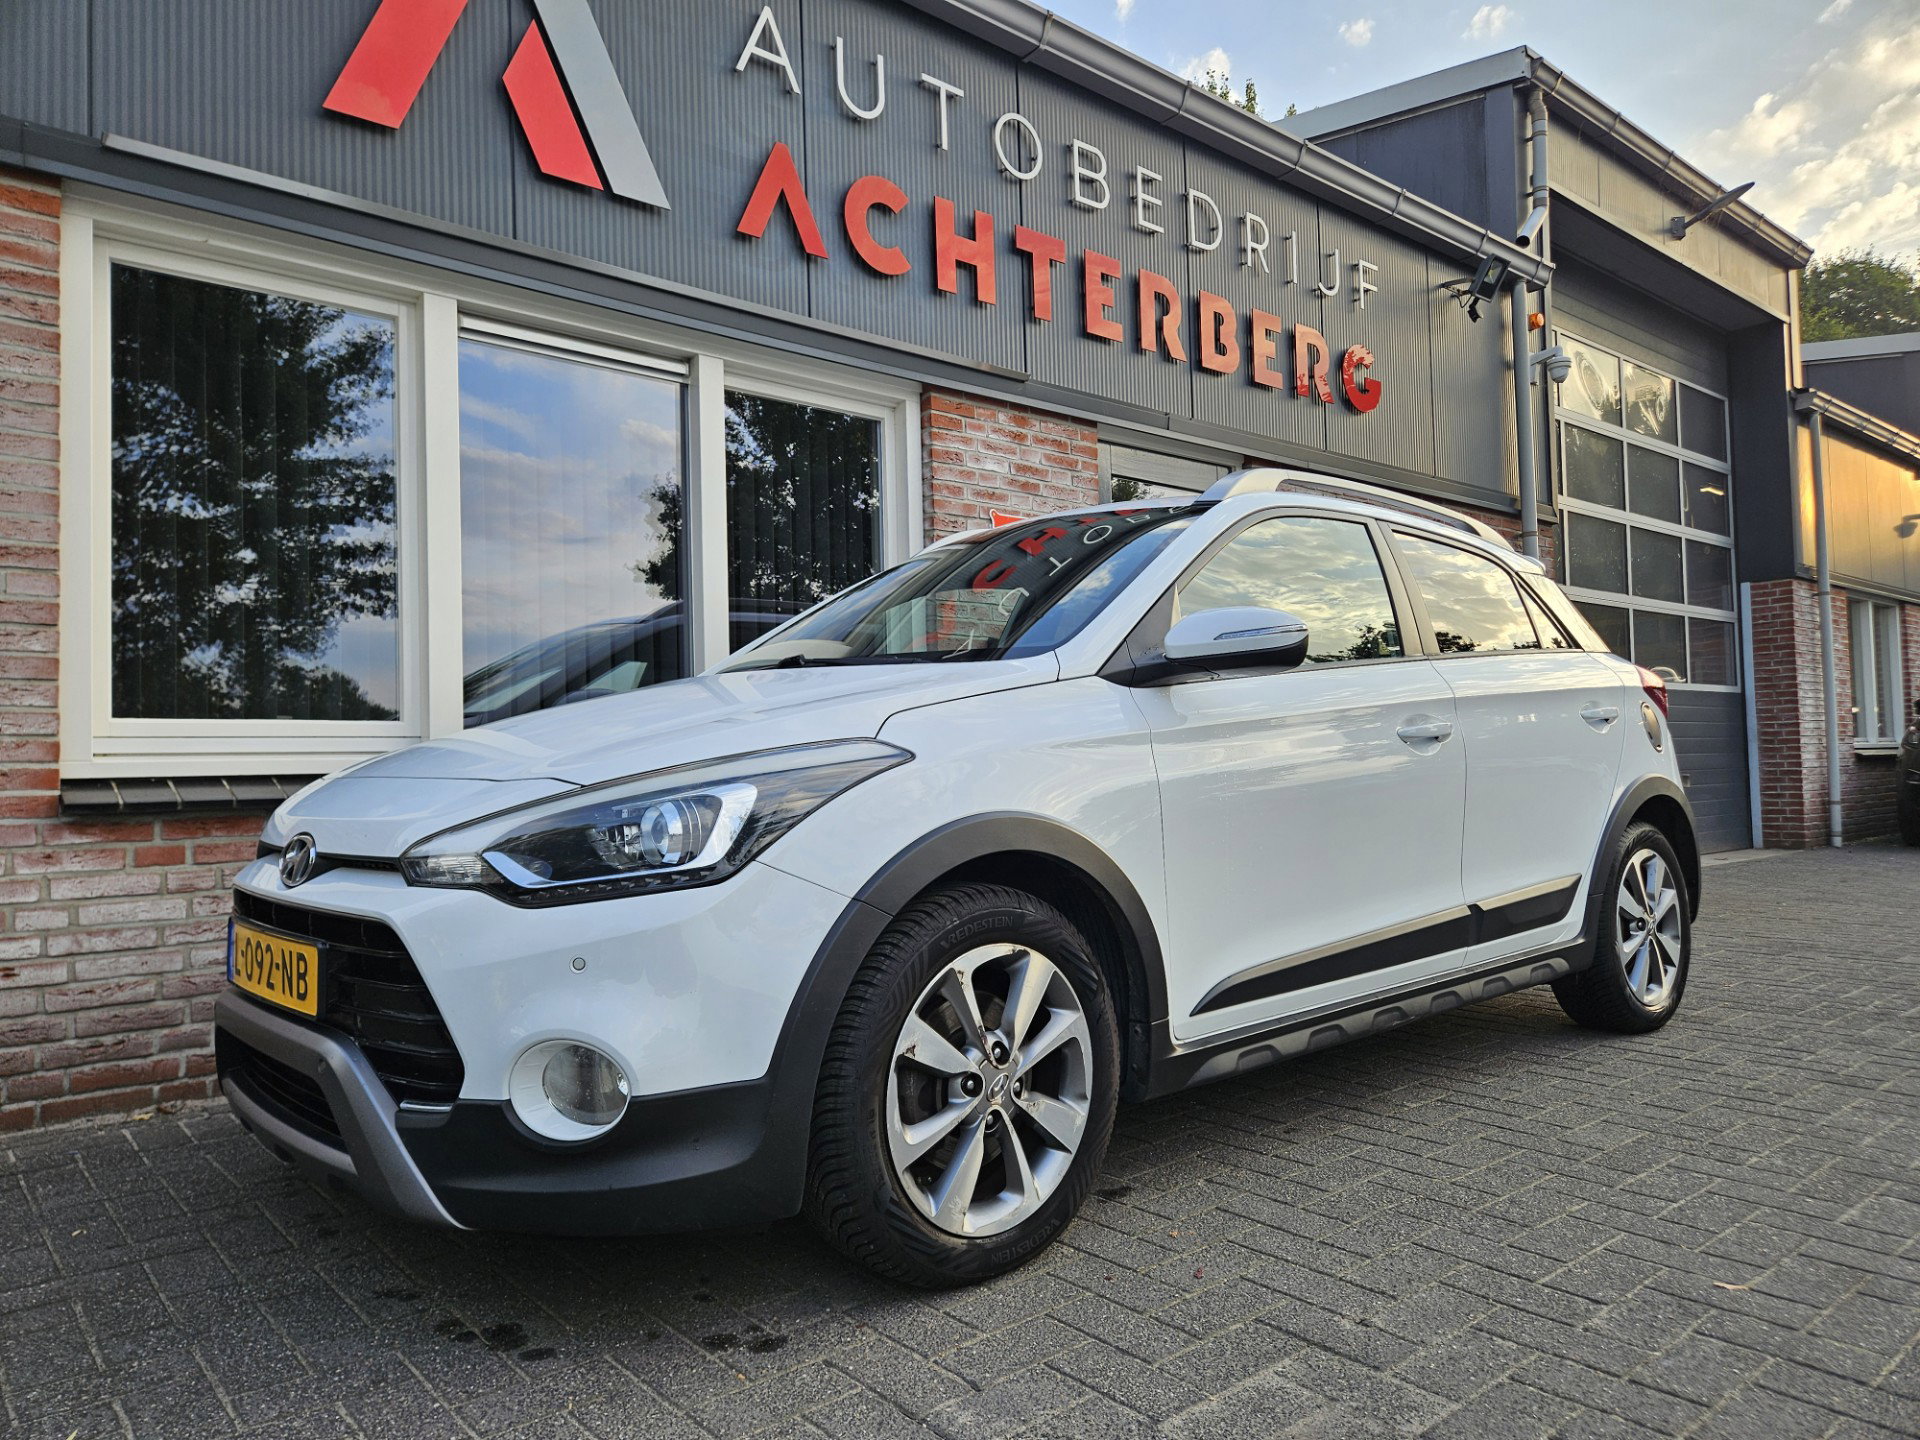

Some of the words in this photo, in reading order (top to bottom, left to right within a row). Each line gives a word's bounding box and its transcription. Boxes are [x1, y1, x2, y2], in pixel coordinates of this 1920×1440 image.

[735, 5, 1379, 310] AUTOBEDRIJF
[737, 141, 1383, 414] ACHTERBERG
[235, 932, 308, 1001] L-092-NB
